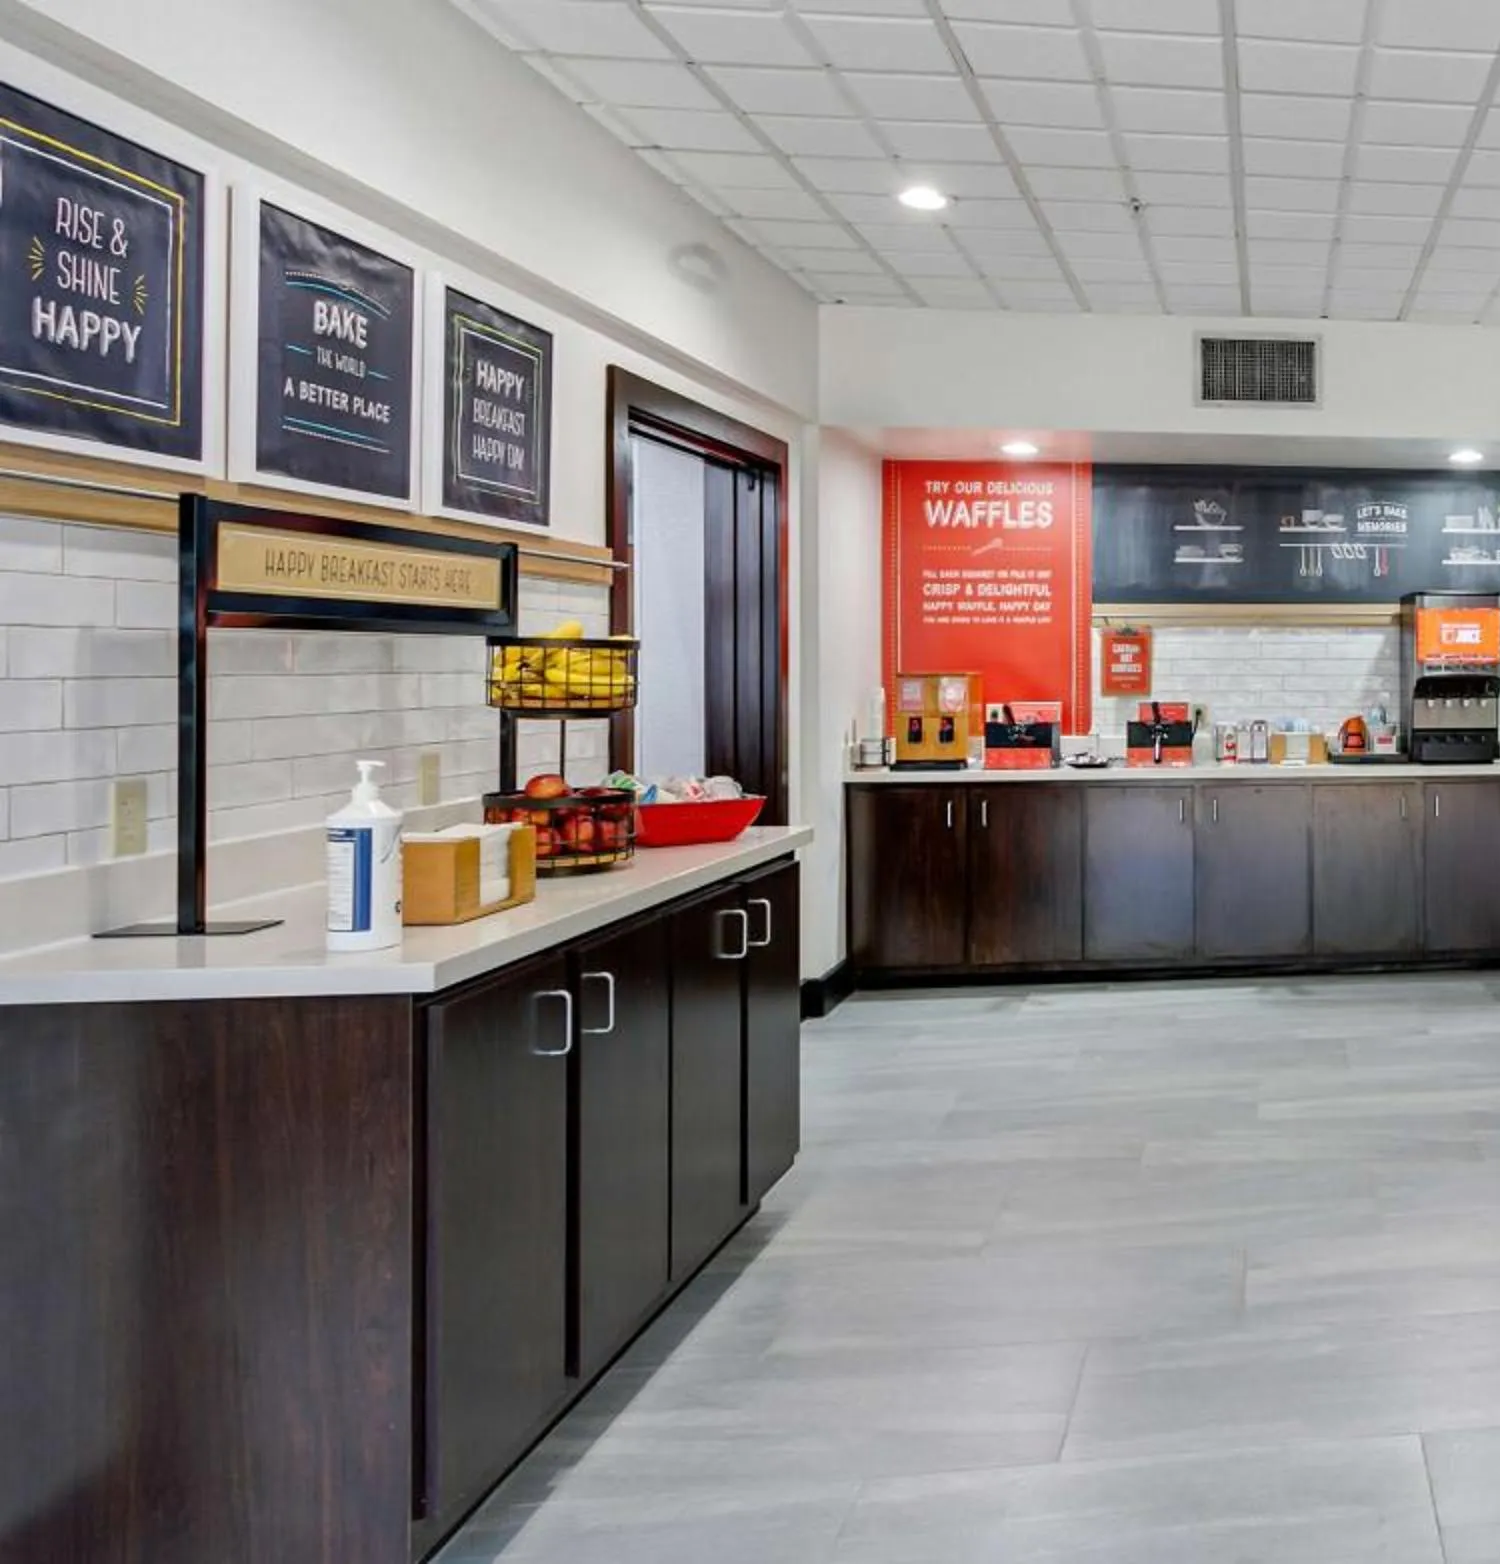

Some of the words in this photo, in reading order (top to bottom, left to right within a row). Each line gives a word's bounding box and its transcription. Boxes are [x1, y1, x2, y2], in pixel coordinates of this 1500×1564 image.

[56, 197, 104, 249] RISE
[110, 217, 128, 258] &
[56, 251, 121, 305] SHINE
[31, 295, 142, 364] HAPPY
[313, 300, 368, 349] BAKE
[283, 376, 294, 398] A
[299, 381, 350, 412] BETTER
[353, 396, 391, 424] PLACE
[476, 359, 525, 401] HAPPY
[472, 397, 526, 438] BREAKFAST
[472, 434, 505, 466] HAPPY
[925, 480, 949, 495] TRY
[954, 480, 983, 495] OUR
[987, 480, 1054, 495] DELICIOUS
[924, 500, 1054, 529] WAFFLES
[265, 547, 316, 578] HAPPY
[321, 555, 397, 588] BREAKFAST
[399, 562, 441, 593] STARTS
[443, 569, 473, 596] HERE
[923, 583, 961, 596] CRISP
[977, 583, 1052, 596] DELIGHTFUL
